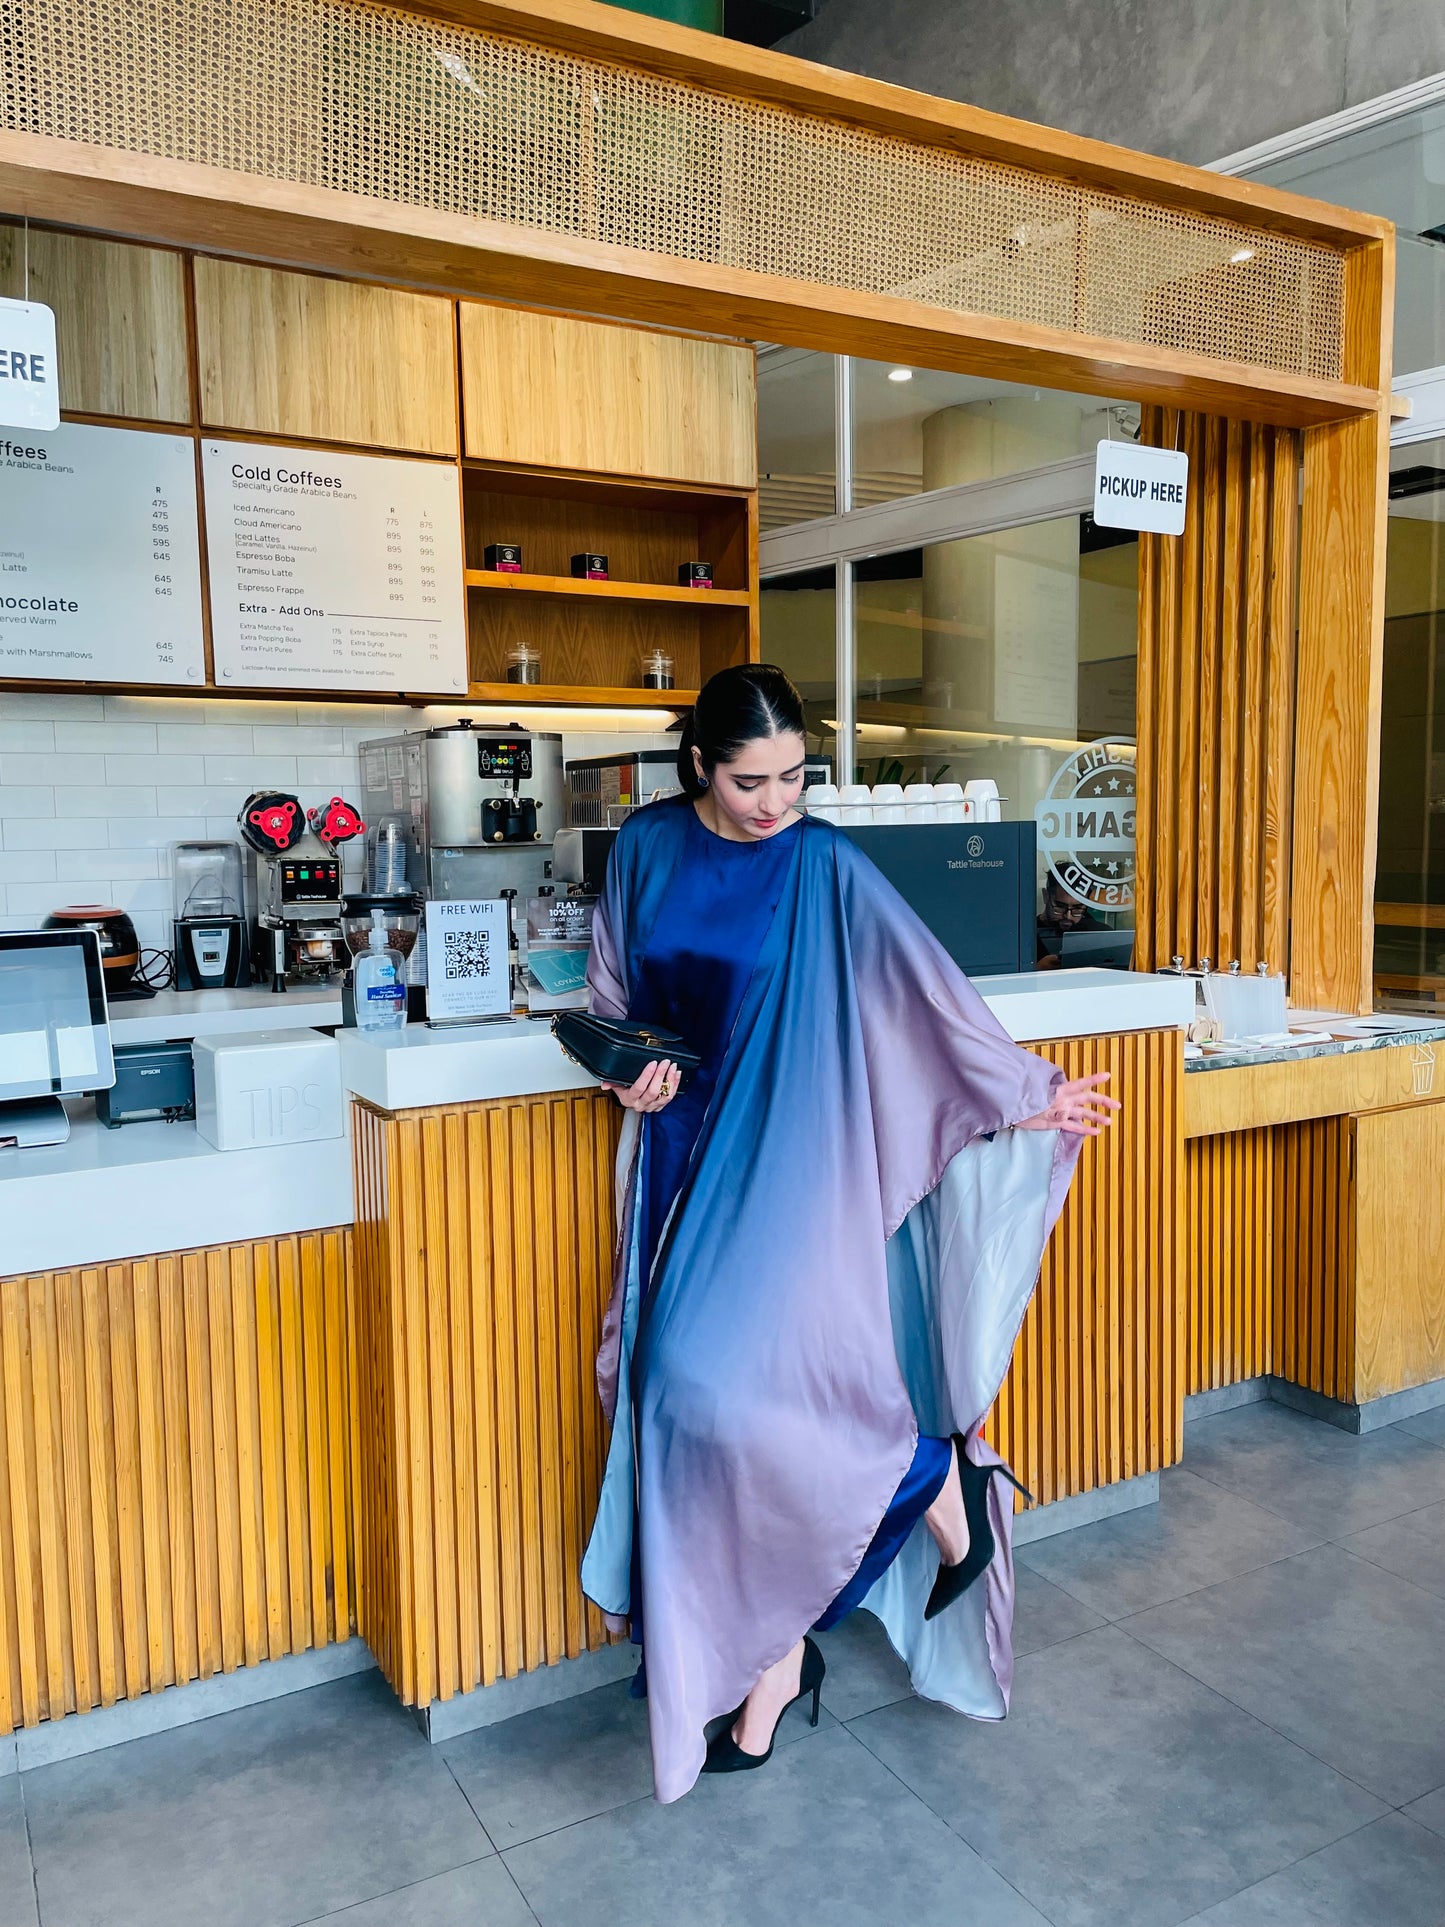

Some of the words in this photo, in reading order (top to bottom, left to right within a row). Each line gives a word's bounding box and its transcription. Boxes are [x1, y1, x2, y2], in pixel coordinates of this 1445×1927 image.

[6, 459, 42, 470] Arabica
[45, 463, 74, 474] Beans
[232, 464, 270, 481] Cold
[277, 469, 342, 488] Coffees
[232, 480, 271, 493] Specialty
[273, 484, 298, 494] Grade
[300, 487, 331, 497] Arabica
[333, 490, 358, 500] Beans
[1100, 475, 1147, 498] PICKUP
[1151, 481, 1183, 504] HERE
[152, 500, 168, 508] 475
[233, 504, 251, 512] Iced
[253, 505, 295, 516] Americano
[152, 511, 169, 520] 475
[234, 518, 258, 527] Cloud
[260, 520, 302, 531] Americano
[385, 517, 399, 526] 775
[152, 524, 169, 533] 595
[254, 534, 280, 543] Lattes
[386, 532, 401, 540] 895
[419, 534, 434, 543] 995
[153, 538, 170, 547] 595
[387, 545, 402, 553] 895
[420, 548, 434, 556] 995
[153, 552, 171, 561] 645
[236, 551, 273, 561] Espresso
[275, 554, 295, 562] Boba
[2, 563, 28, 572] Latte
[236, 566, 270, 576] Tiramisu
[271, 569, 293, 577] Latte
[387, 563, 403, 571] 895
[154, 575, 172, 583] 645
[155, 588, 173, 596] 645
[237, 583, 274, 592] Espresso
[277, 586, 304, 595] Frappe
[239, 603, 267, 614] Extra
[279, 605, 300, 615] Add
[303, 607, 324, 617] Ons
[29, 616, 57, 625] Warm
[258, 635, 284, 643] Popping
[156, 642, 173, 650] 645
[29, 648, 93, 659] Marshmallows
[158, 655, 174, 663] 745
[946, 860, 968, 869] Tattle
[968, 860, 1004, 868] Teahouse
[440, 904, 466, 915] FREE
[469, 904, 493, 914] WIFI
[556, 901, 578, 910] FLAT
[549, 909, 567, 917] 10%
[567, 908, 585, 916] OFF
[240, 1083, 321, 1140] TIPS
